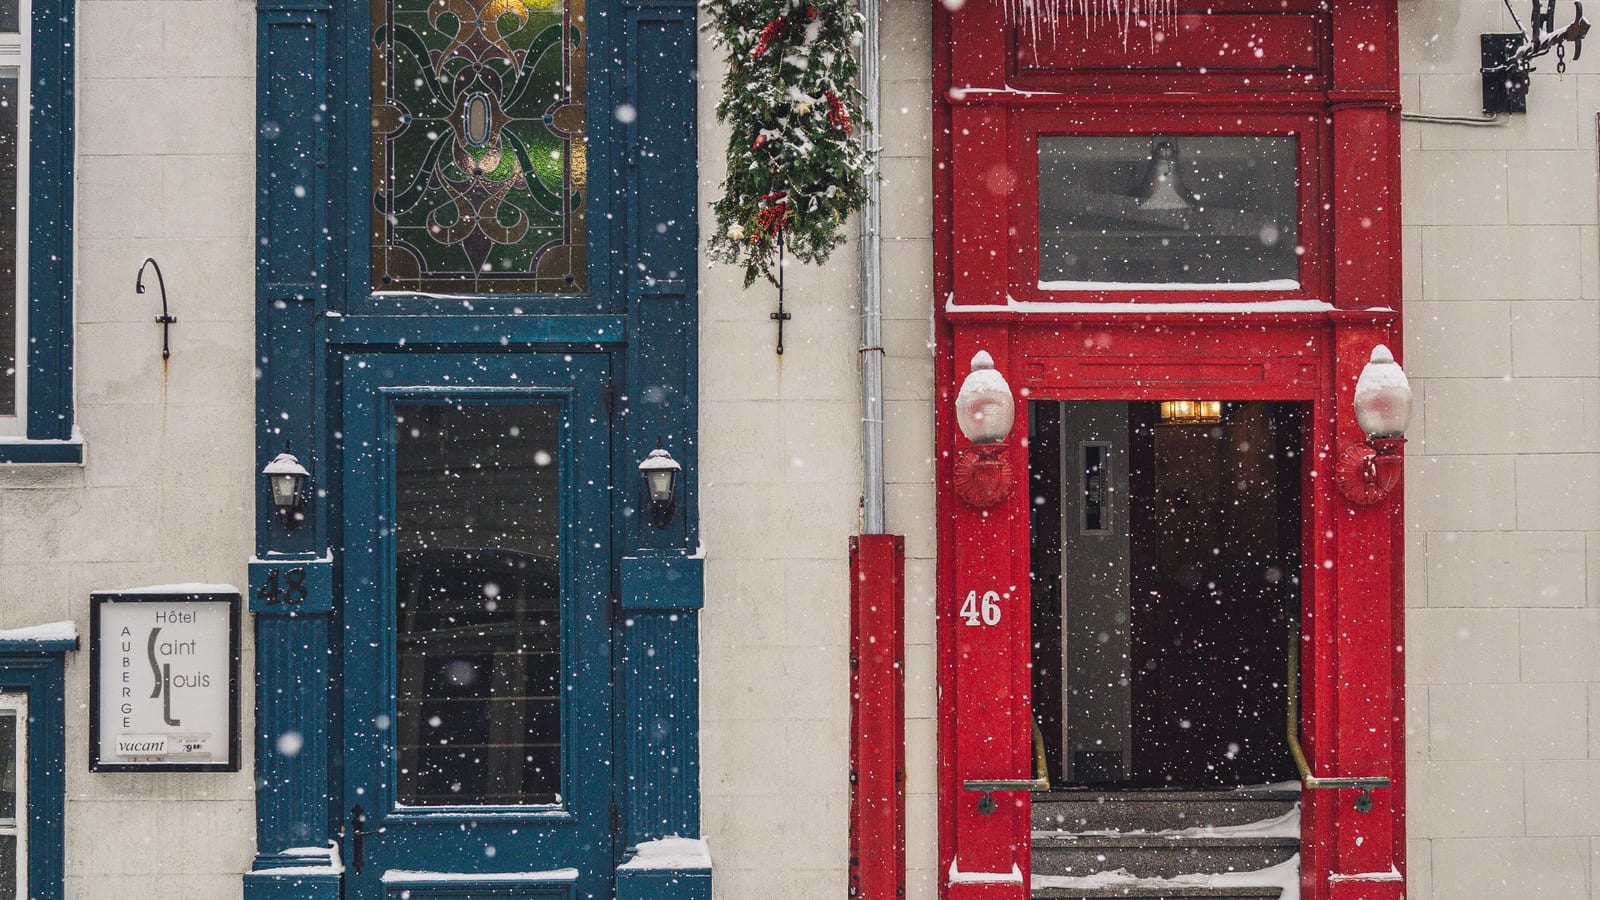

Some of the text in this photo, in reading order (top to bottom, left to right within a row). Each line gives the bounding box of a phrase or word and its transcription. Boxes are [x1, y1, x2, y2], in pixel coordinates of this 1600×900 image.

[257, 567, 307, 605] 48
[156, 611, 196, 623] Hôtel
[960, 590, 1001, 626] 46
[121, 626, 132, 728] AUBERGE
[147, 627, 196, 698] Saint
[163, 663, 210, 726] Louis
[119, 741, 164, 751] vacant
